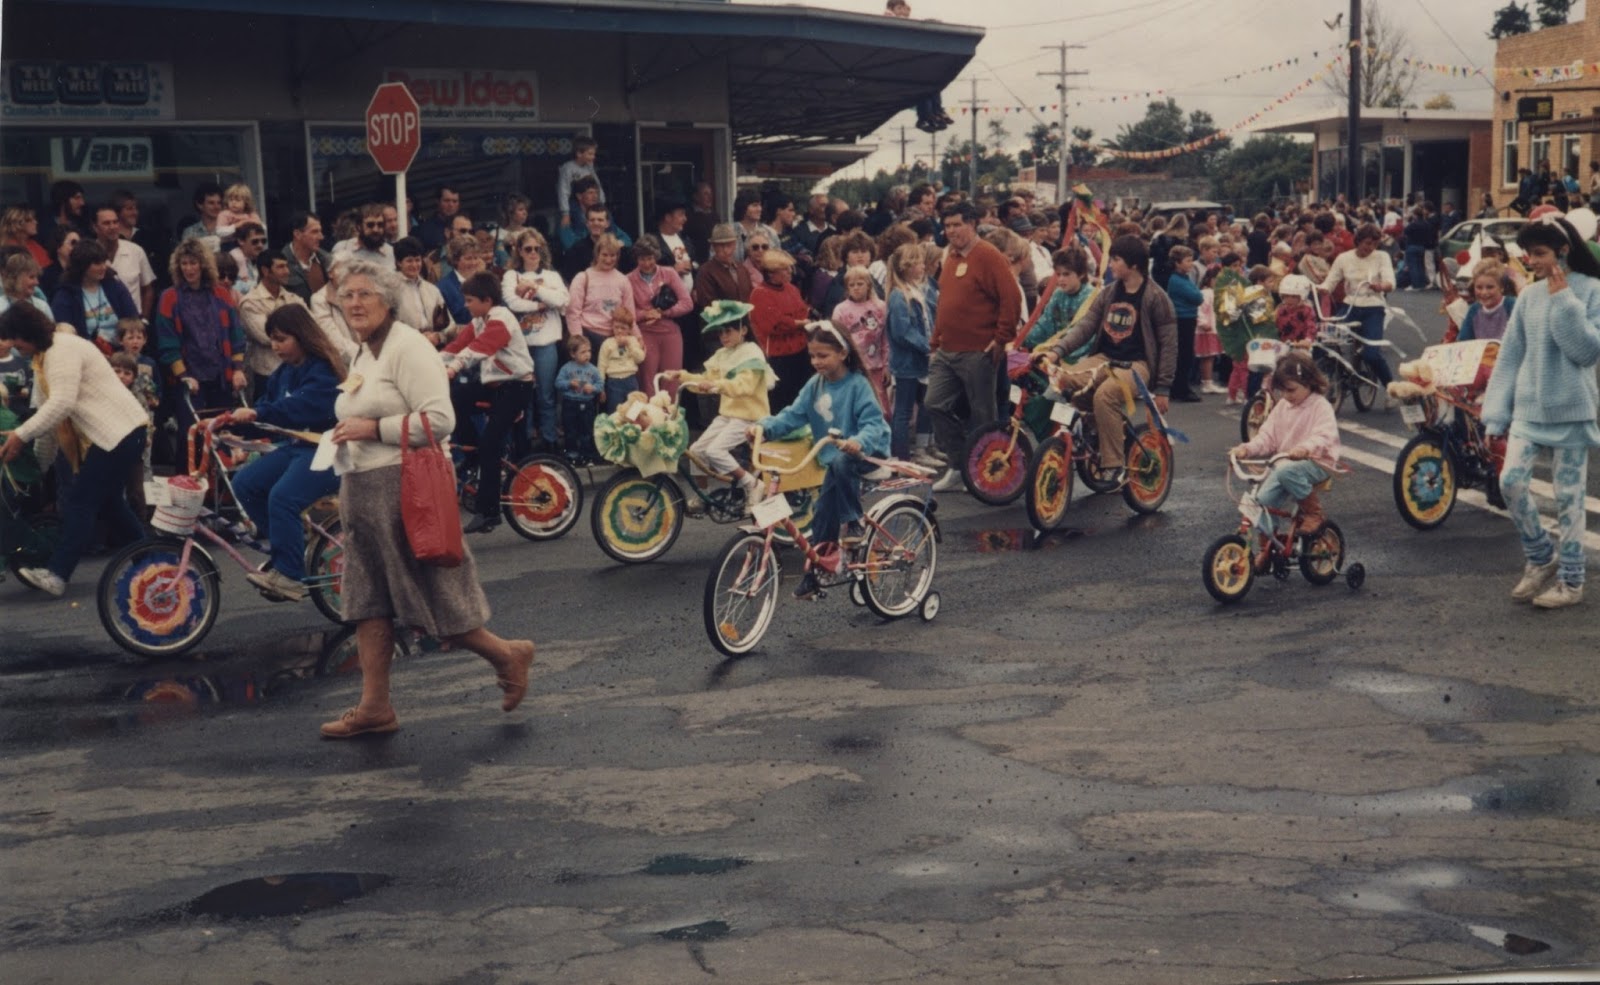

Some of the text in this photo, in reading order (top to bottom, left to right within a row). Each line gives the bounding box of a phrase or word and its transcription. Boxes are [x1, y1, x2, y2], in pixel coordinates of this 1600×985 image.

[19, 66, 51, 79] TV
[66, 66, 98, 79] TV
[111, 67, 143, 80] TV
[464, 71, 533, 107] Idea
[370, 112, 416, 146] STOP
[63, 136, 149, 172] Vana
